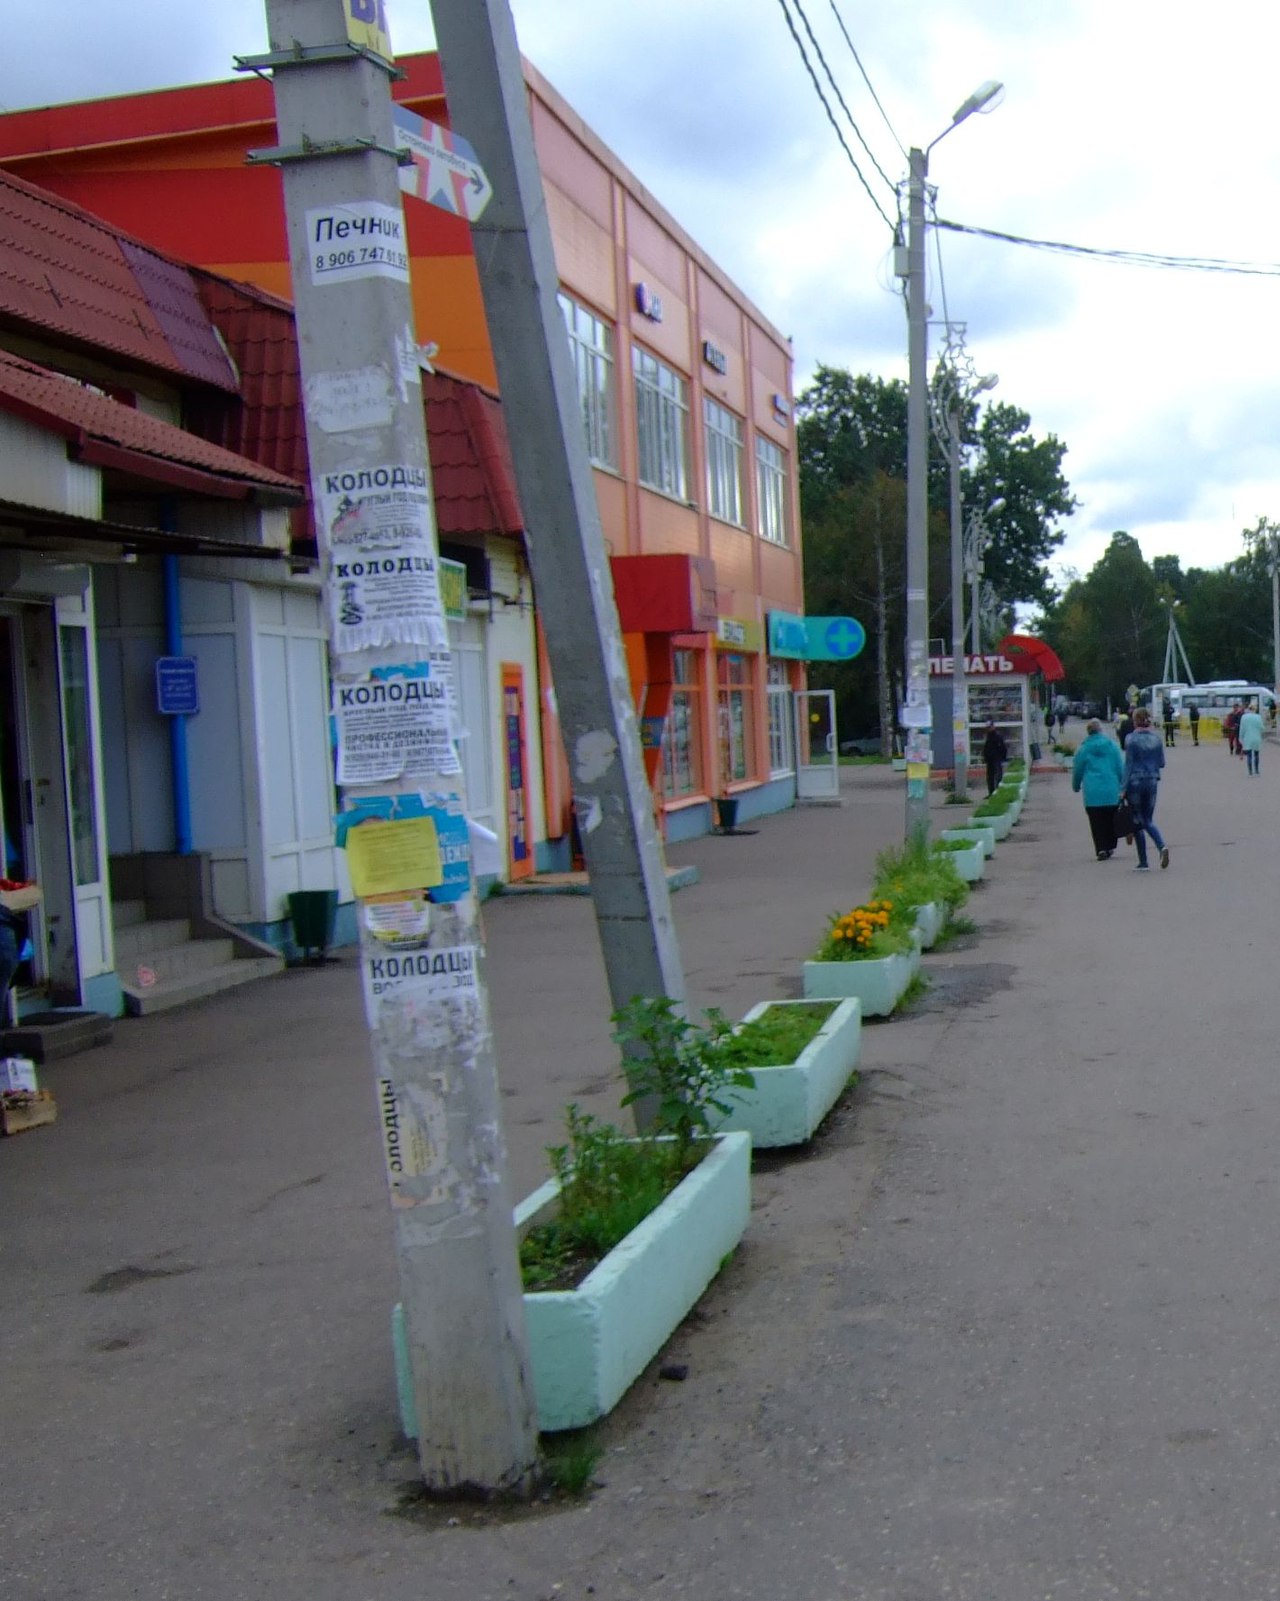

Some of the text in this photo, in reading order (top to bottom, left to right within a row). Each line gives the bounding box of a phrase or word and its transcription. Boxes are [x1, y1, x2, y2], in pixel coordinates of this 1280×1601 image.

[316, 217, 400, 242] Печник
[316, 255, 324, 269] 8
[329, 250, 355, 267] 906
[360, 246, 385, 262] 747
[326, 467, 426, 494] КОЛОДЦЫ
[341, 680, 445, 706] КОЛОДЦЫ
[371, 950, 472, 979] КОЛОДЦЫ
[381, 1079, 403, 1188] ОЛОДЦЫ
